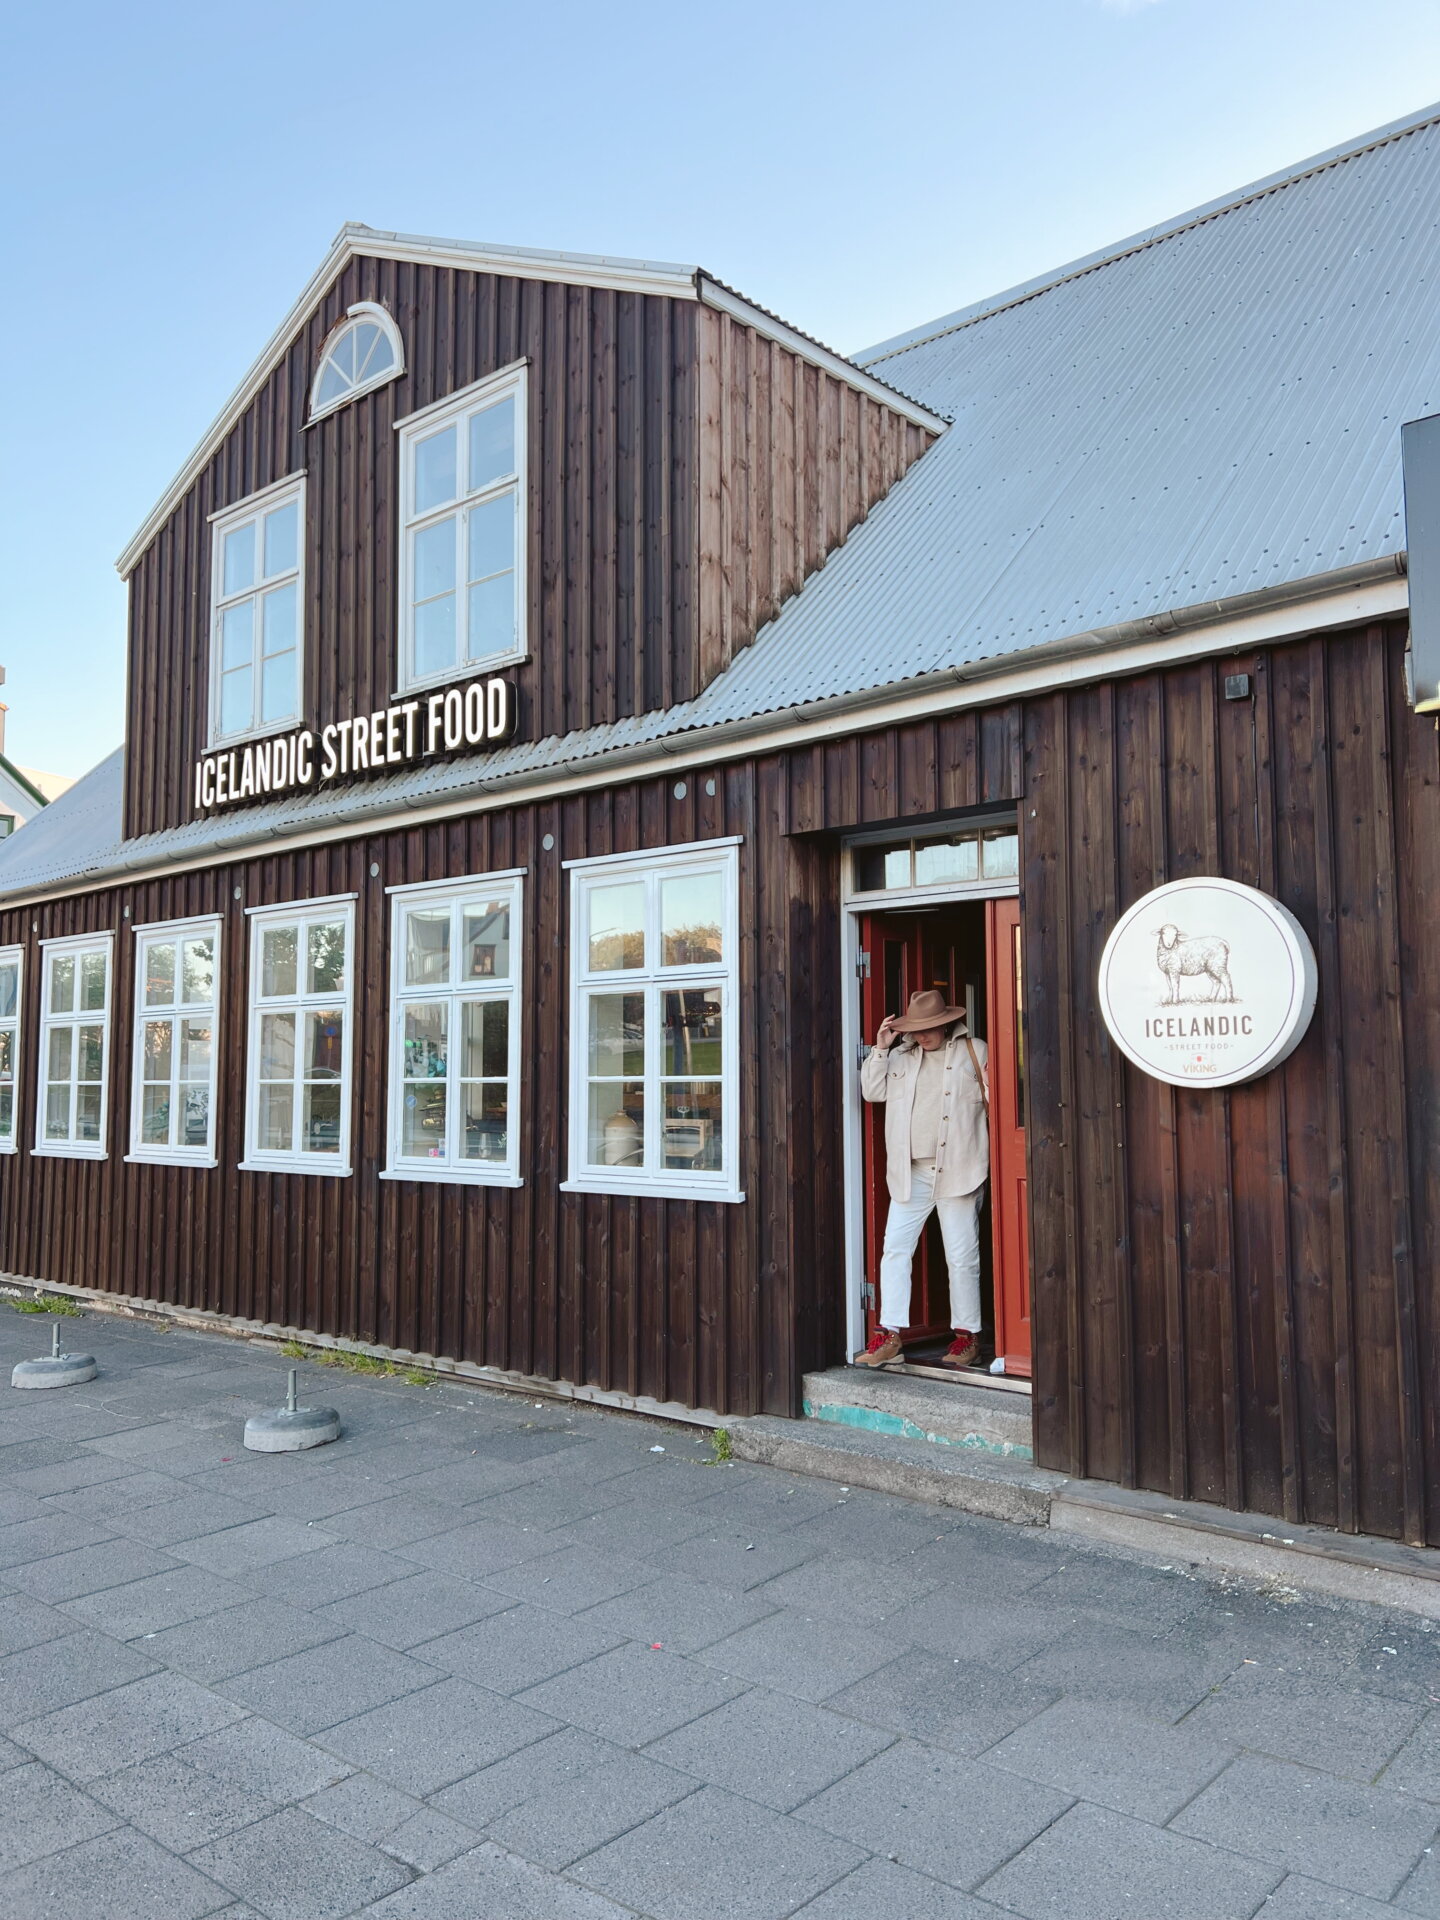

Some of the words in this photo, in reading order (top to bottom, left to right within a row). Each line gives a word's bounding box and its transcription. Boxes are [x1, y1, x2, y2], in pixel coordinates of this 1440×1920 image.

[194, 730, 313, 809] ICELANDIC
[320, 700, 419, 779] STREET
[428, 677, 507, 752] FOOD
[1145, 1015, 1253, 1038] ICELANDIC
